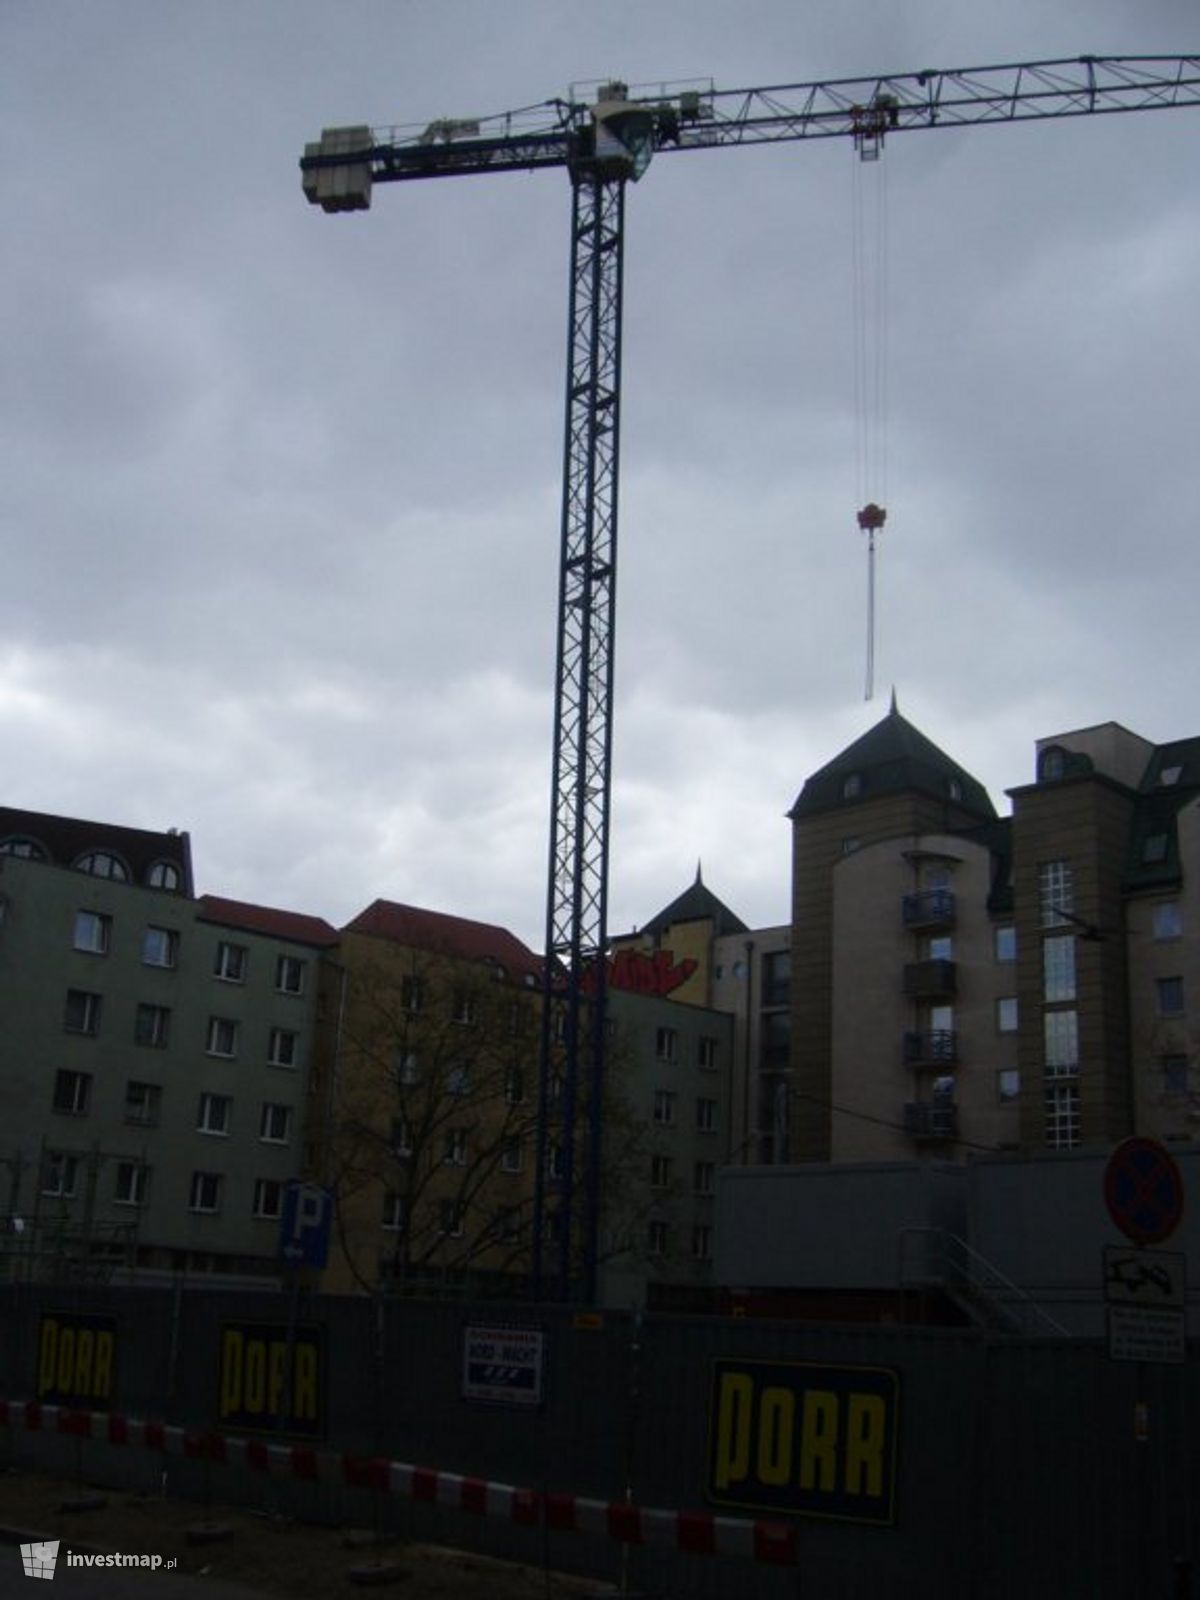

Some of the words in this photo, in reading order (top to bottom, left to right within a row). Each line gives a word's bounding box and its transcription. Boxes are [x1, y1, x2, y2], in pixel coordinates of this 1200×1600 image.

[293, 1184, 323, 1241] P
[38, 1318, 114, 1399] PORR
[715, 1371, 886, 1498] PORR
